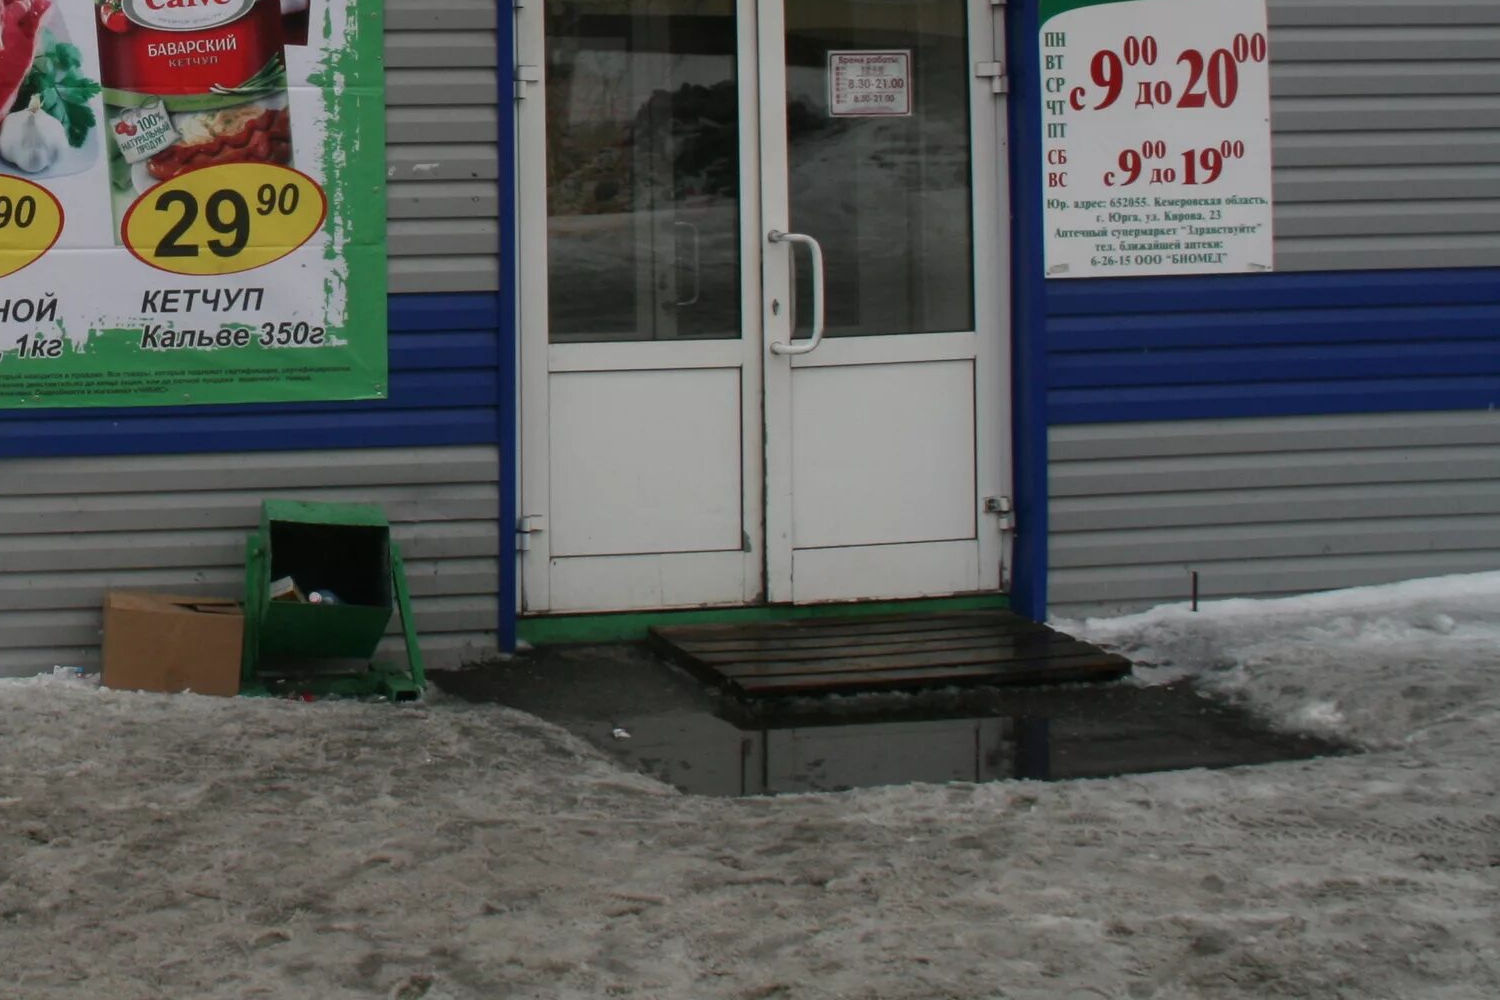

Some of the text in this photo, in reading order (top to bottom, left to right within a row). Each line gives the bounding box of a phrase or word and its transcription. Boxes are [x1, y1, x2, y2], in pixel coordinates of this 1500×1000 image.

[147, 34, 237, 57] БАВАРСКИЙ
[1044, 32, 1066, 48] ПН
[168, 55, 219, 67] КЕТЧУП
[1045, 55, 1064, 70] ВТ
[1045, 77, 1065, 92] СР
[1069, 86, 1086, 111] с
[1135, 80, 1172, 109] до
[1046, 100, 1066, 115] ЧТ
[137, 112, 165, 131] 100%
[121, 121, 171, 151] НАТУРАЛЬНЫЙ
[1047, 123, 1067, 138] ПТ
[1047, 149, 1067, 165] СБ
[1048, 172, 1068, 188] ВС
[1103, 171, 1115, 187] с
[1149, 168, 1176, 185] до
[1046, 199, 1069, 211] Юр.
[1154, 197, 1222, 208] Кемеровская
[1209, 209, 1221, 220] 23
[1054, 227, 1108, 238] Аптечный
[1111, 227, 1177, 239] супермаркет
[1094, 243, 1116, 252] тел.
[1119, 240, 1180, 251] ближайшей
[1090, 255, 1131, 266] 6-26-15
[1134, 254, 1162, 265] ООО
[140, 287, 264, 313] КЕТЧУП
[140, 321, 326, 349] Кальве 350г
[15, 334, 64, 359] 1кг
